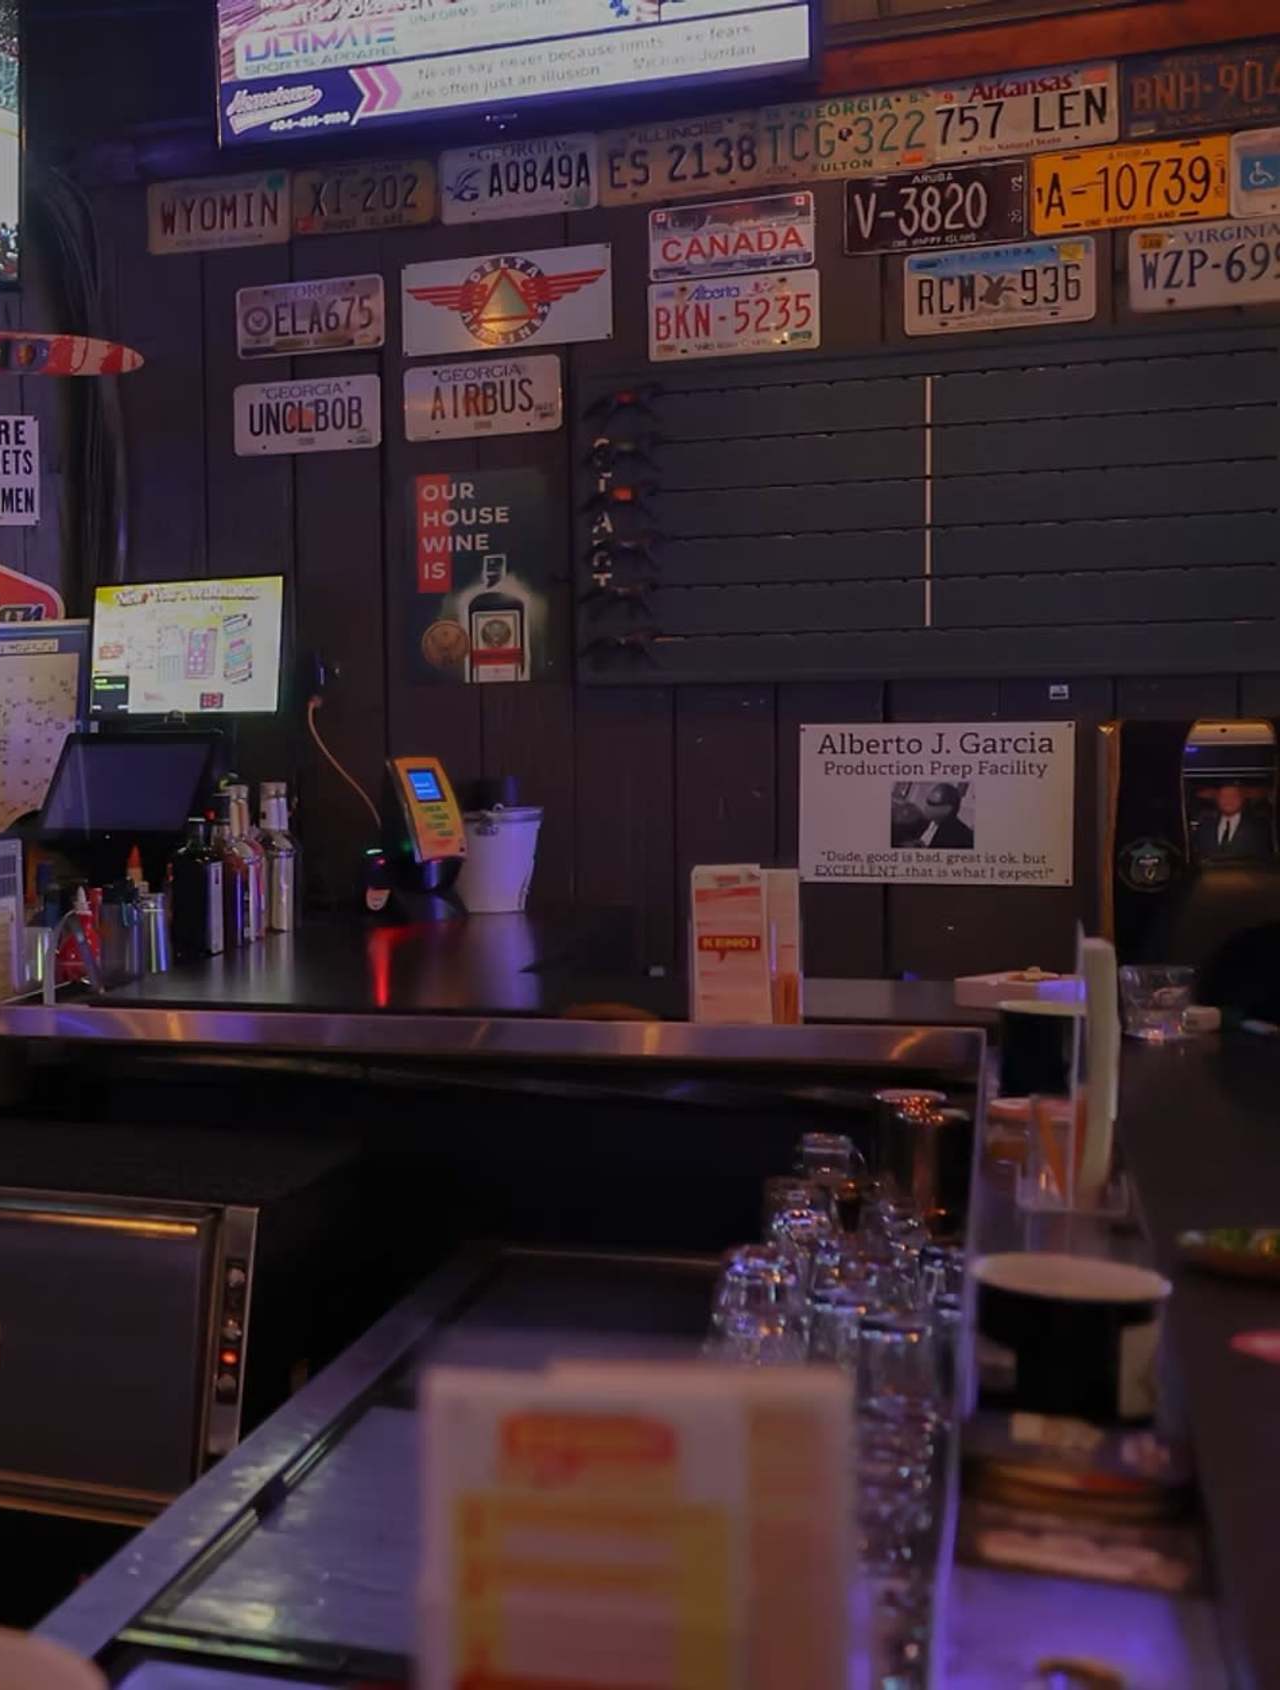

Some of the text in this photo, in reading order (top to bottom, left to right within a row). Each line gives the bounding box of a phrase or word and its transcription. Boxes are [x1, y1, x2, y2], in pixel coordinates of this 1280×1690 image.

[244, 21, 396, 63] ULTIMATE
[467, 62, 493, 77] say
[548, 44, 614, 64] because
[442, 64, 600, 97] often just an illusion
[969, 71, 1072, 103] Arkansas
[937, 85, 1107, 145] 757 LEN
[637, 122, 725, 144] ILLINOIS
[766, 109, 926, 164] TCG 322
[489, 151, 591, 198] AQ849A
[608, 134, 757, 190] ES 2138
[1044, 155, 1212, 219] A-10739
[160, 190, 279, 236] WYOMIN
[854, 180, 988, 239] V-3820
[661, 226, 804, 263] CANADA
[470, 256, 540, 284] DELTA
[1140, 242, 1280, 290] WZP-69
[687, 284, 740, 301] Alberta
[918, 263, 1081, 316] RCM 936
[273, 294, 374, 338] ELA675
[439, 362, 522, 383] GEORGIA
[265, 384, 344, 400] GEORGIA
[430, 377, 534, 421] AIRBUS
[248, 396, 363, 437] UNCLBOB
[422, 482, 476, 503] OUR
[423, 506, 511, 529] HOUSE
[421, 533, 490, 554] WINE
[423, 562, 447, 580] IS
[818, 731, 1054, 755] Alberto J. Garcia
[824, 760, 1049, 779] Production Prep Facility
[866, 851, 1046, 866] good is great is but
[938, 866, 949, 878] is
[951, 866, 986, 878] what
[701, 936, 758, 950] KENO!
